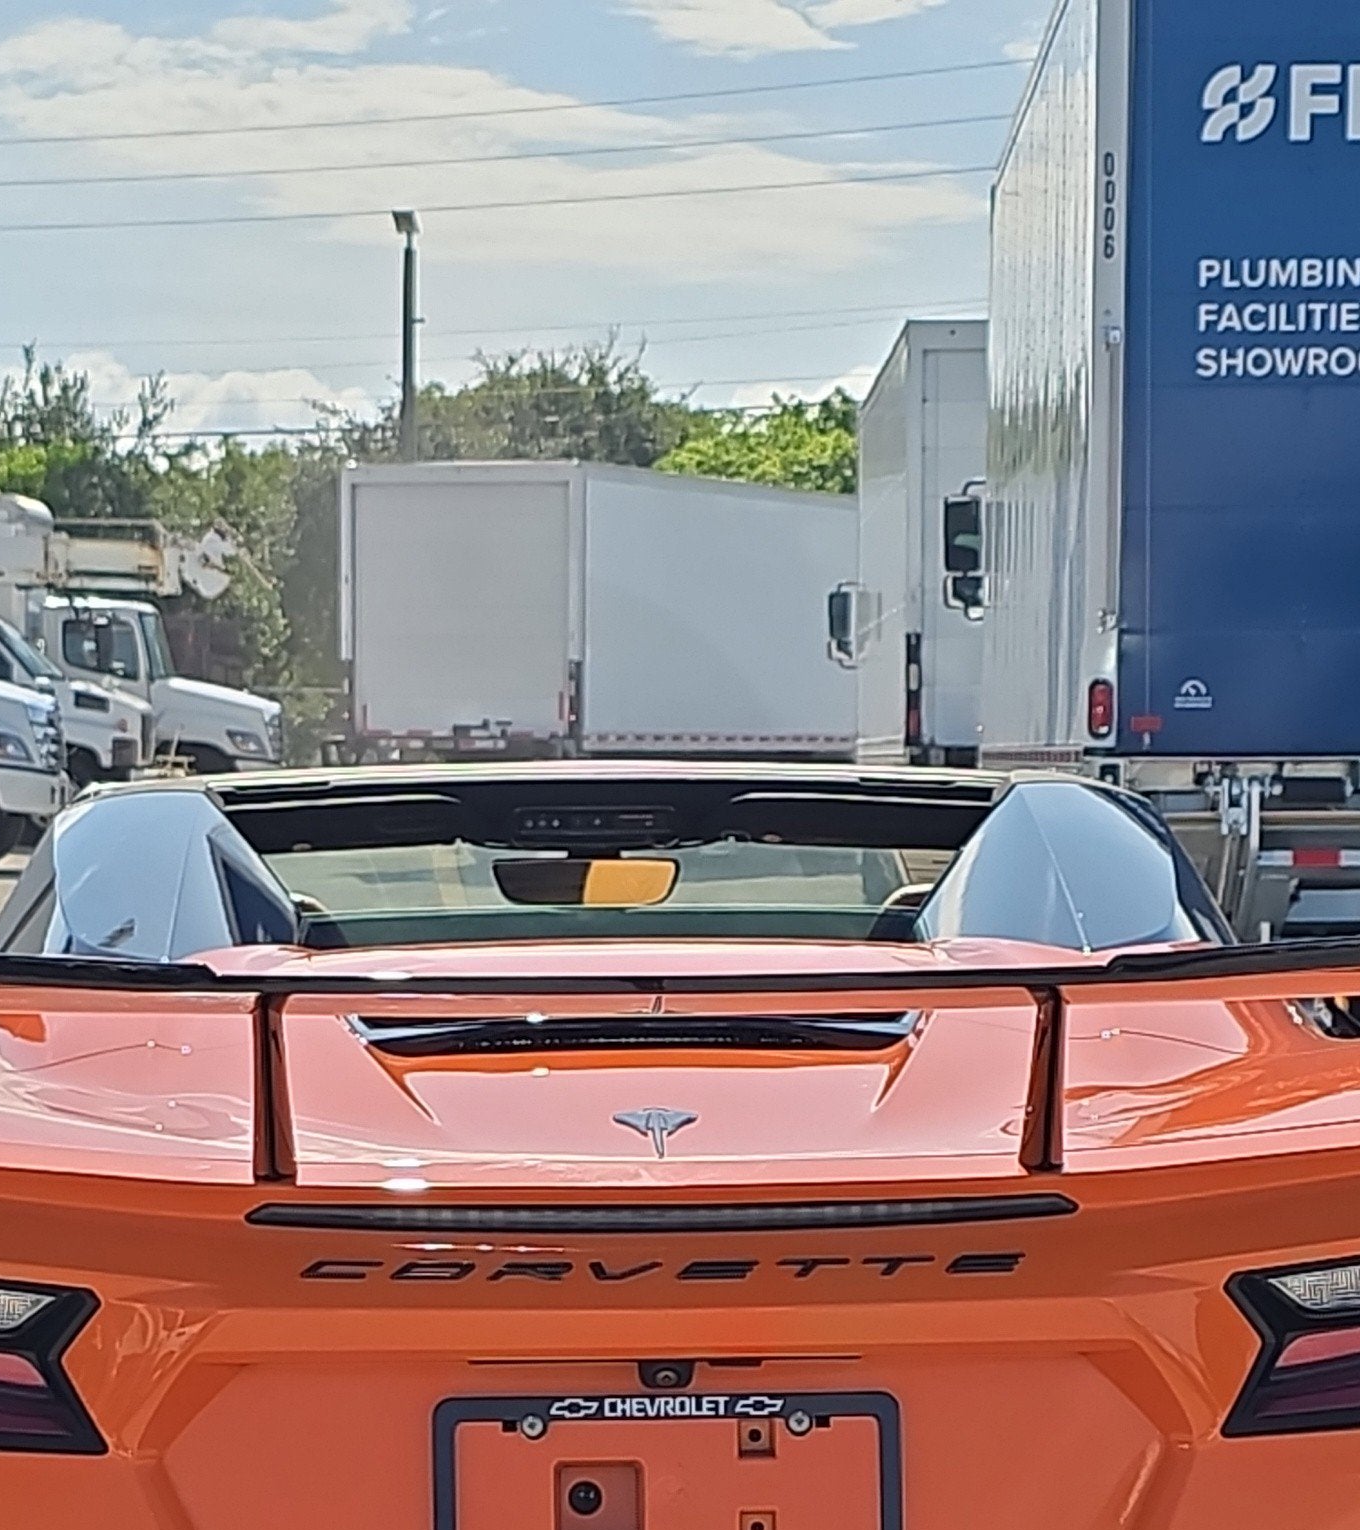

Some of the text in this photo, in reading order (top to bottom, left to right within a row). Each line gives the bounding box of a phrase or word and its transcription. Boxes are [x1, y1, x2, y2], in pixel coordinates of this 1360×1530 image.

[1103, 150, 1115, 260] 0006
[299, 1252, 1027, 1281] CORVETTE
[603, 1396, 730, 1418] CHEVROLET
